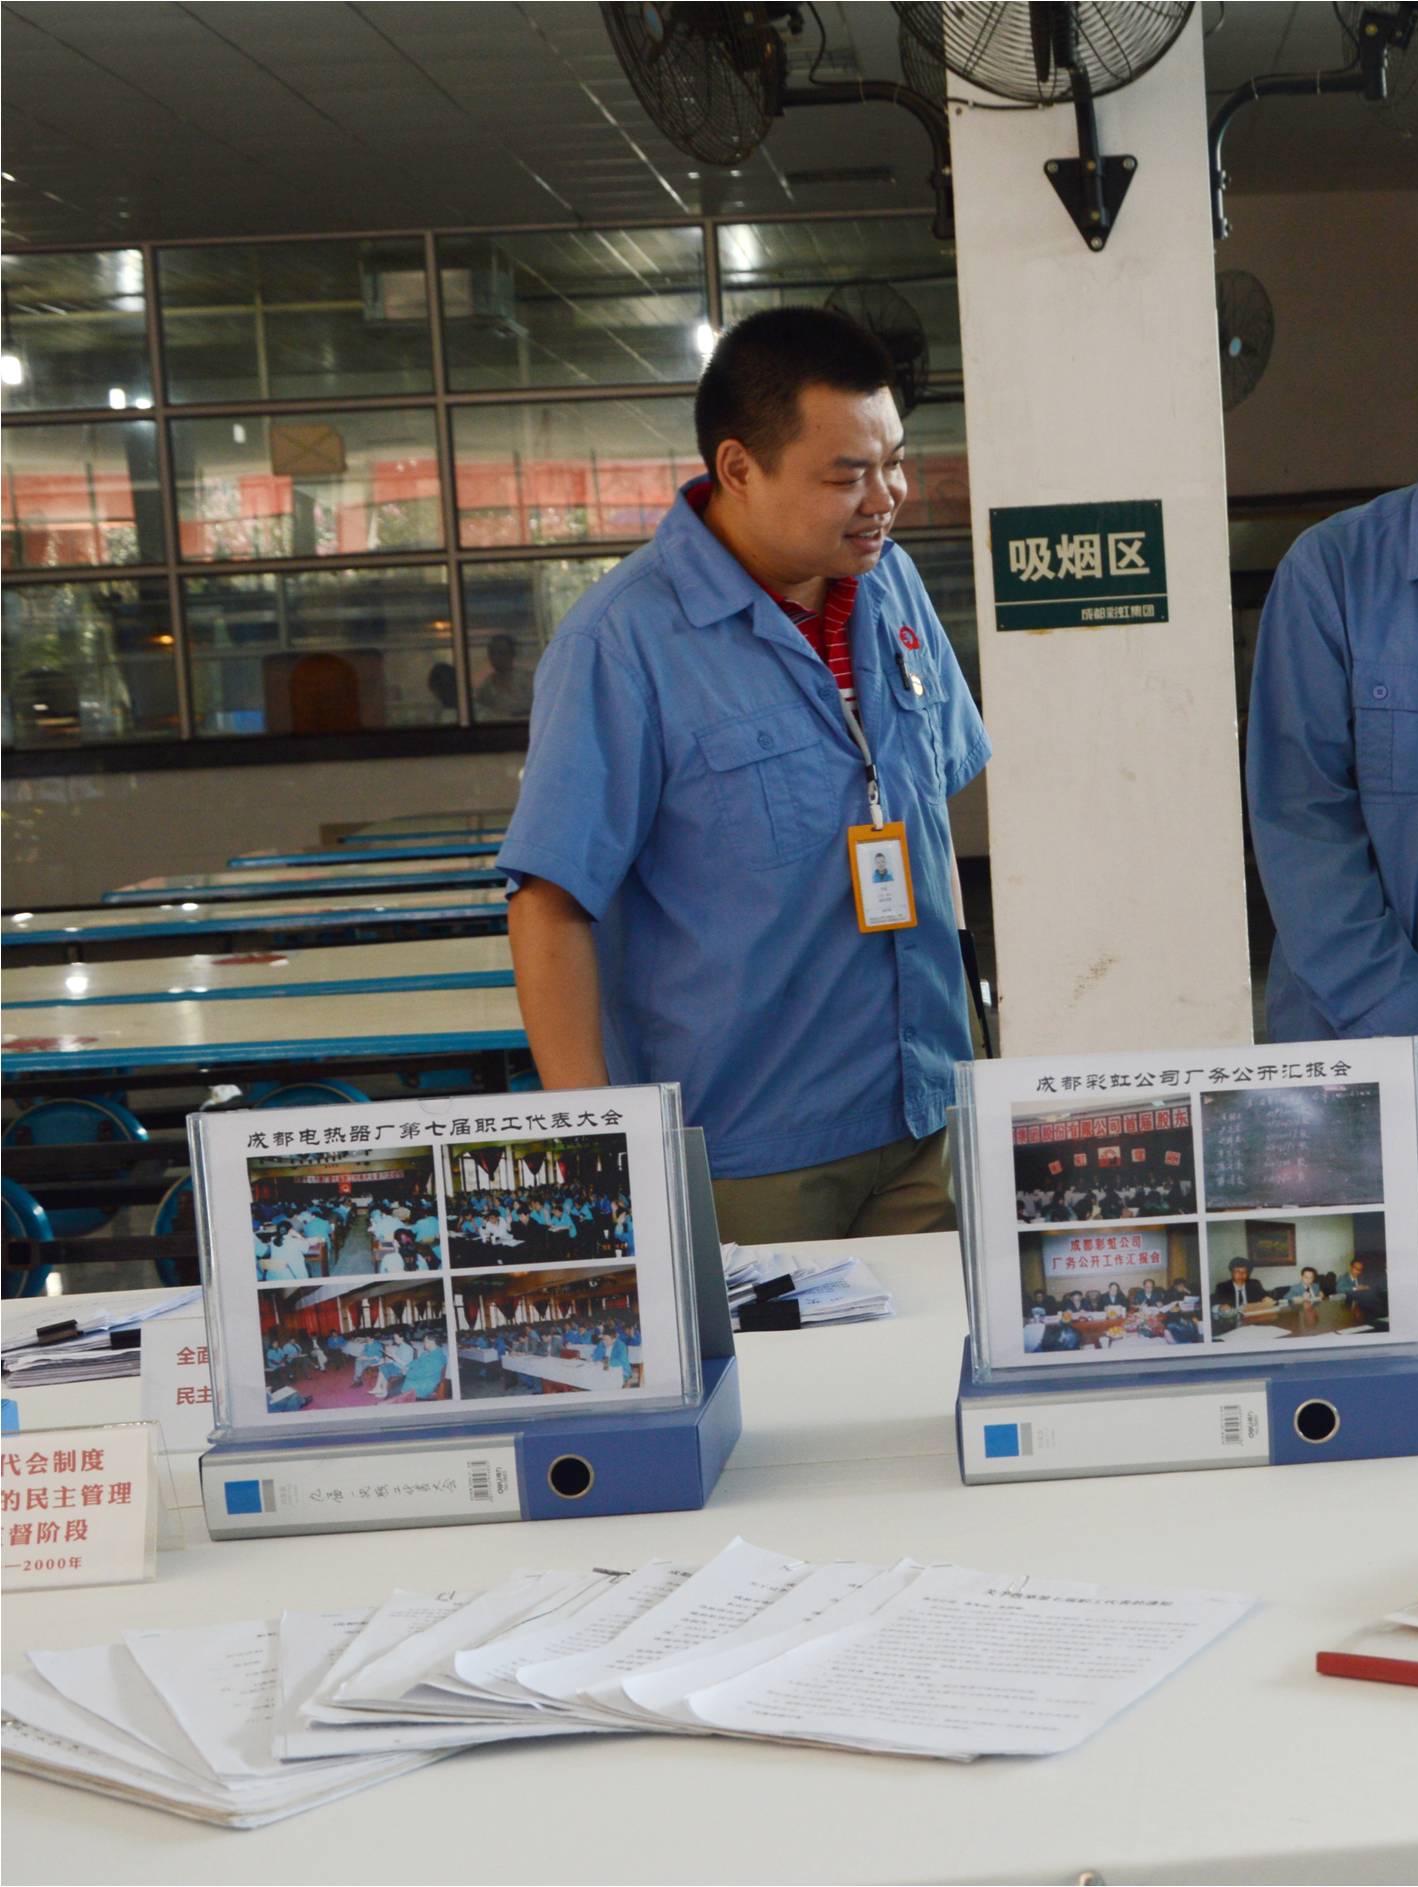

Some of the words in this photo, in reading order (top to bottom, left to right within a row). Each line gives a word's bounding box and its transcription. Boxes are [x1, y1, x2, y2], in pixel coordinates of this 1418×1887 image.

[1008, 531, 1151, 583] 吸烟区
[1081, 604, 1155, 621] 成都彩虹集团
[1035, 1060, 1353, 1093] 成都彩虹公司厂务公开汇报会
[247, 1109, 624, 1149] 成都电热器厂第七届职工代表大会
[1070, 1234, 1143, 1252] 成都彩虹公司
[1051, 1251, 1161, 1270] 厂务公开工作汇报会
[176, 1385, 214, 1406] 民主
[1, 1448, 105, 1477] 代会制度
[1, 1482, 132, 1512] 的民主管理
[1, 1519, 88, 1546] 督阶段
